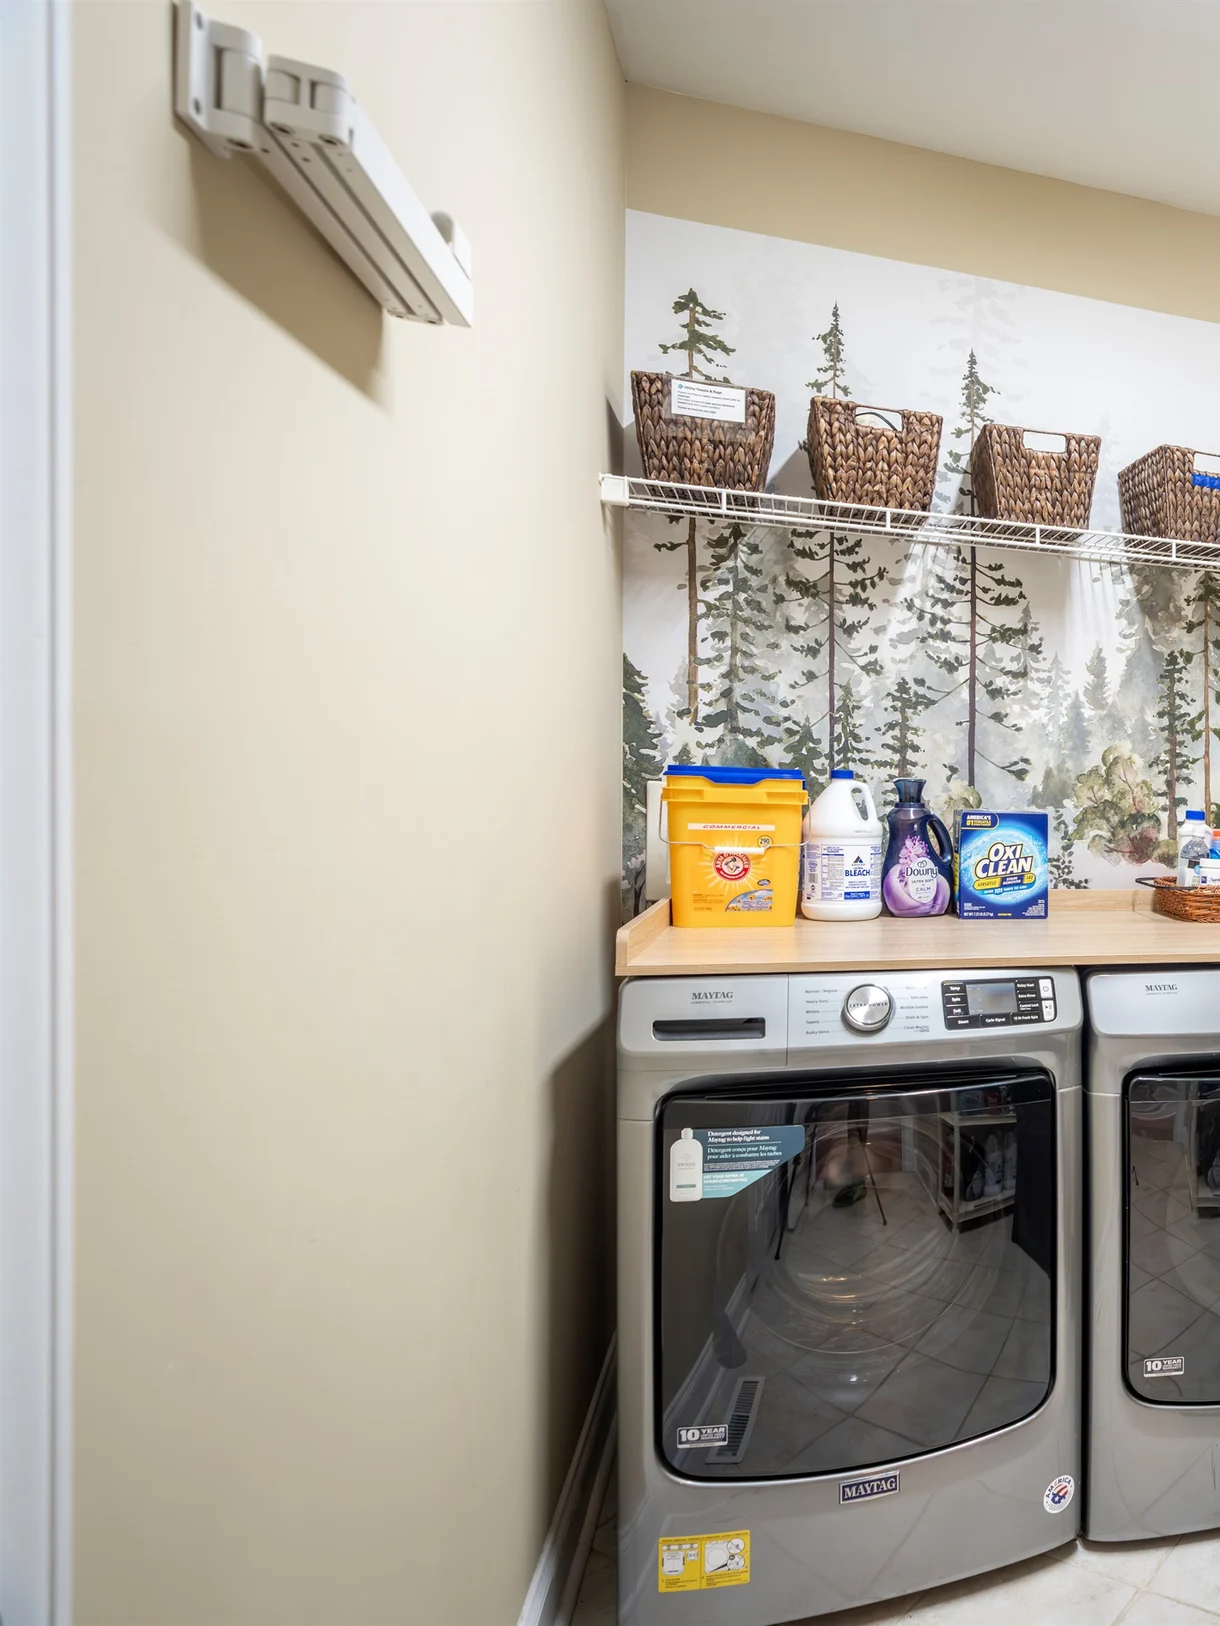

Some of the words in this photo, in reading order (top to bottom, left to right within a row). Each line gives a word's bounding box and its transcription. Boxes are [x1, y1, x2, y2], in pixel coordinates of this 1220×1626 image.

[989, 842, 1023, 861] OXI
[906, 866, 938, 878] Downy
[976, 856, 1033, 878] CLEAN
[691, 992, 733, 1000] MAYTAG
[1146, 1360, 1162, 1371] 10
[680, 1429, 700, 1442] 10
[844, 1478, 896, 1498] MAYTAG
[1046, 1477, 1071, 1498] AMERICA
